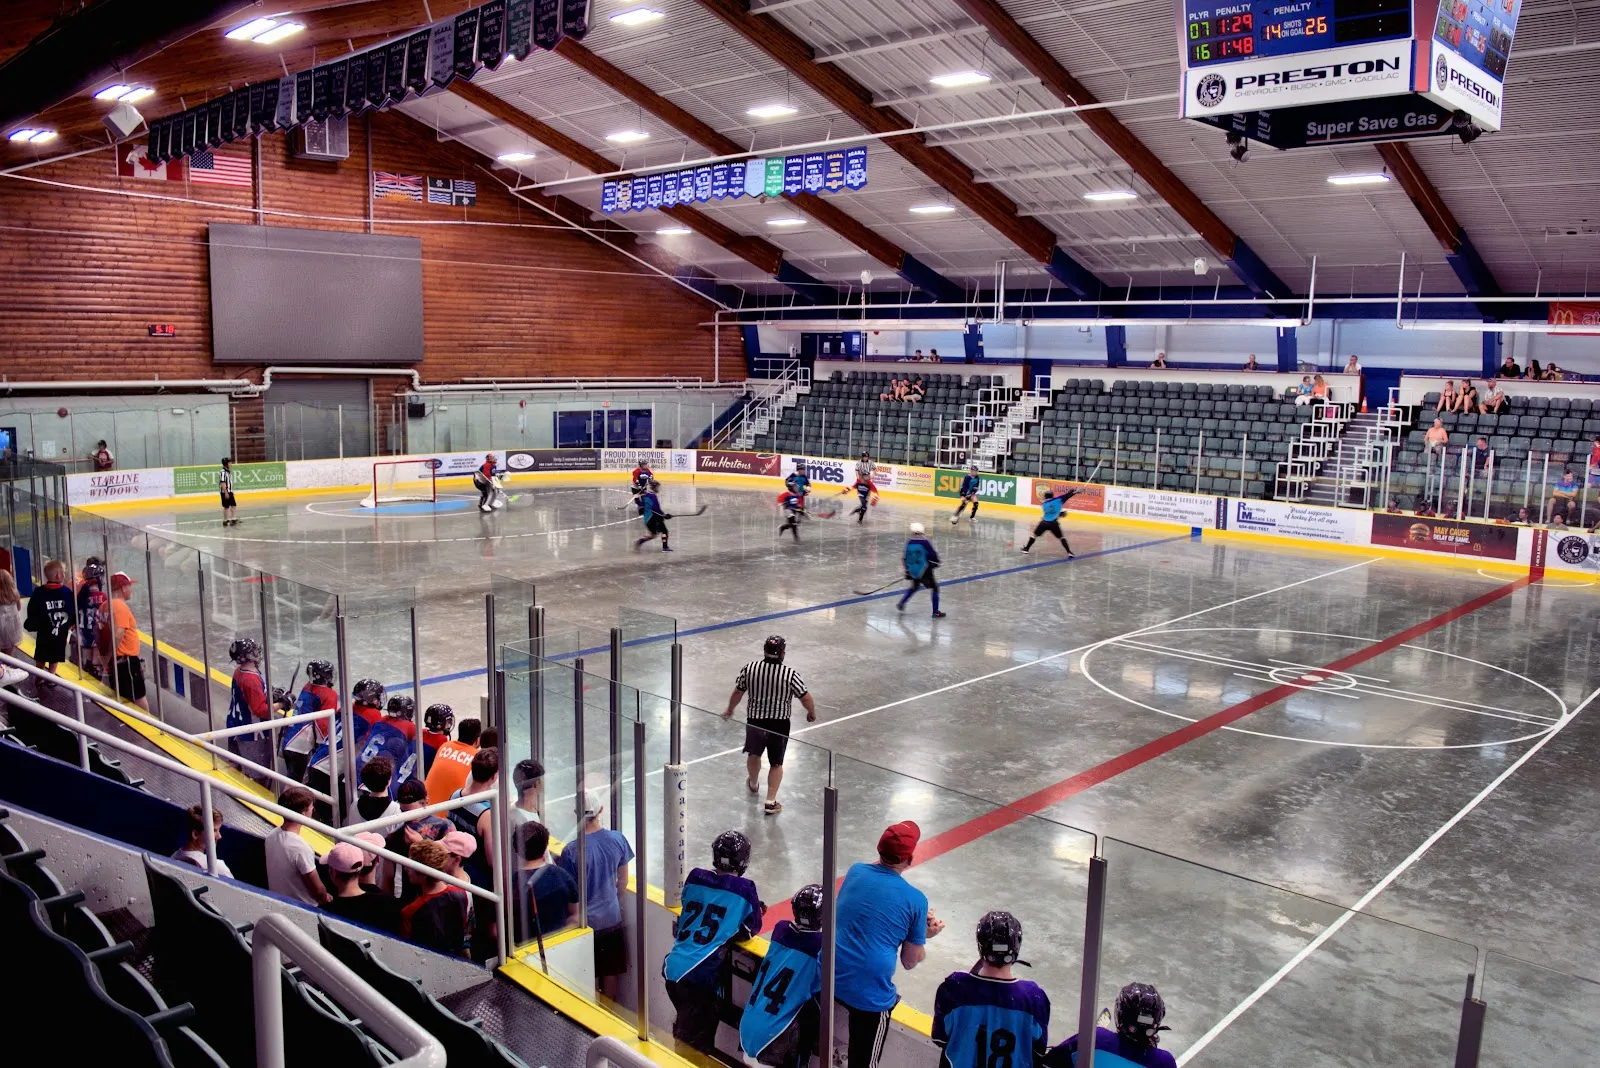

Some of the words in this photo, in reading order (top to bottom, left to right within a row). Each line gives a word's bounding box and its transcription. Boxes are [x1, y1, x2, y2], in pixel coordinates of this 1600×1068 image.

[1189, 11, 1209, 20] PLYR
[1216, 4, 1251, 16] PENALTY
[1273, 2, 1311, 15] PENALTY
[1190, 22, 1210, 39] 07
[1221, 14, 1253, 34] 1:29
[1265, 24, 1281, 40] 14
[1281, 29, 1290, 38] ON
[1290, 27, 1305, 36] GOAL
[1283, 19, 1302, 29] SHOTS
[1305, 16, 1327, 35] 26
[1196, 43, 1210, 60] 16
[1221, 37, 1253, 56] 1:48
[1235, 57, 1400, 90] PRESTON
[1234, 86, 1283, 98] CHEVROLET
[1291, 82, 1317, 91] BUICK
[1325, 78, 1347, 87] GMC
[1354, 73, 1400, 83] CADILLAC
[1450, 68, 1500, 109] PRESTON
[1306, 120, 1354, 141] Super
[1358, 117, 1398, 132] Save
[1403, 112, 1438, 128] Gas
[700, 455, 718, 468] Tim
[718, 456, 752, 470] Hortons
[791, 458, 844, 483] Tmes
[806, 459, 844, 468] LANGLEY
[90, 473, 140, 486] STARLINE
[89, 485, 140, 497] WINDOWS
[1107, 499, 1146, 515] PARLOUR
[1433, 526, 1449, 535] MAY
[1449, 528, 1471, 538] CAUSE
[1562, 536, 1587, 545] LANGLEY
[1560, 551, 1586, 564] RIVERMEN
[438, 746, 475, 767] COACH
[677, 779, 687, 889] Cascadia
[676, 901, 728, 946] 25
[750, 959, 796, 1016] 14
[975, 1024, 1017, 1068] 18
